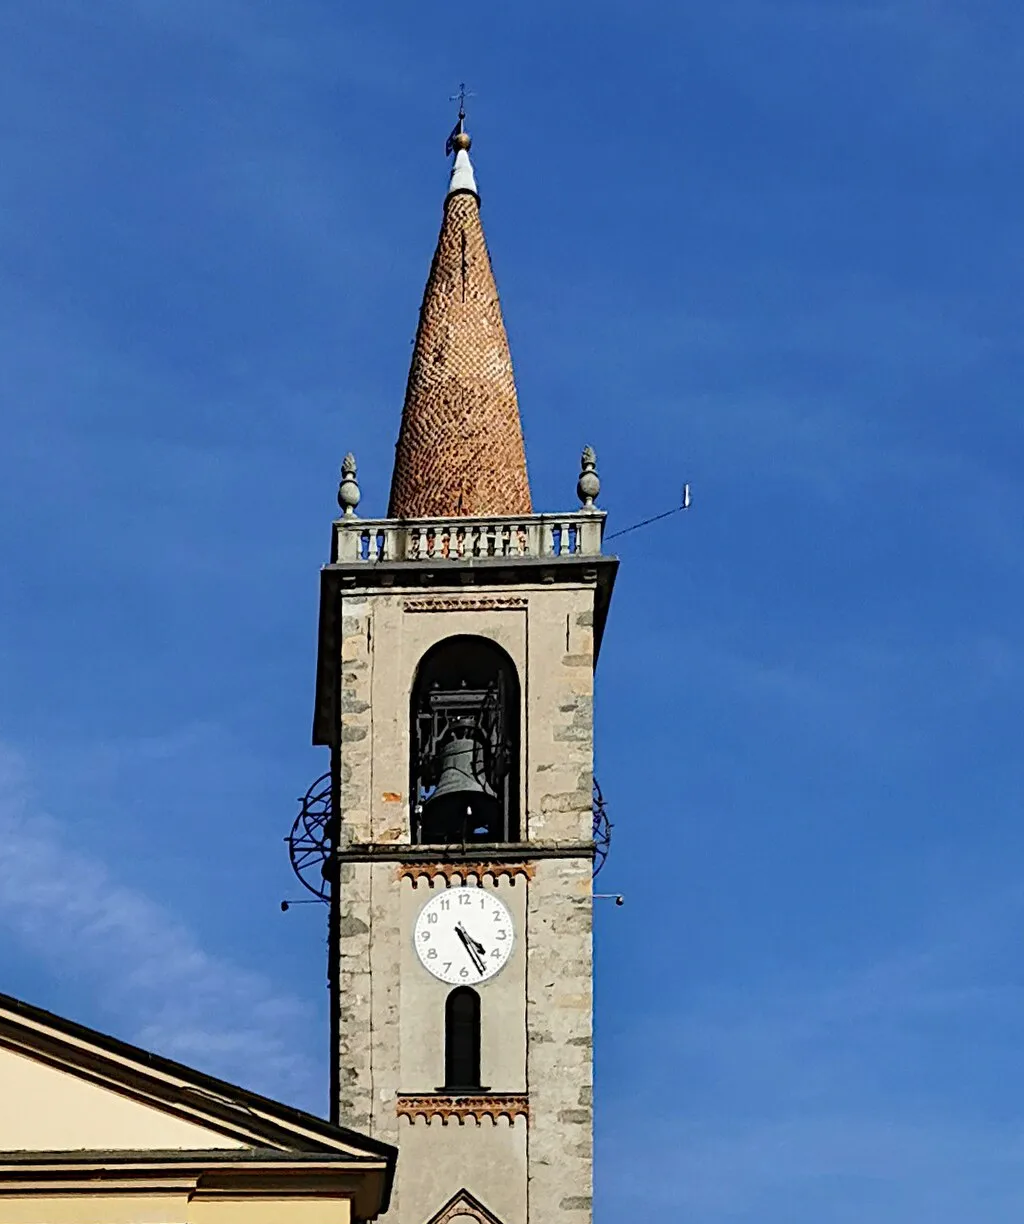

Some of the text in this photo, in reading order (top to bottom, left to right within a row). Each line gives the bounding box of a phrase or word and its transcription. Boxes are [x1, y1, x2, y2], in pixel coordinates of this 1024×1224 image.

[458, 894, 471, 904] 12
[480, 898, 485, 909] 1
[440, 899, 450, 911] 11
[427, 912, 438, 924] 10
[492, 910, 501, 921] 2
[421, 931, 431, 942] 9
[495, 930, 507, 940] 3
[427, 949, 437, 959] 8
[490, 948, 501, 959] 4
[443, 962, 452, 973] 7
[460, 967, 469, 977] 6
